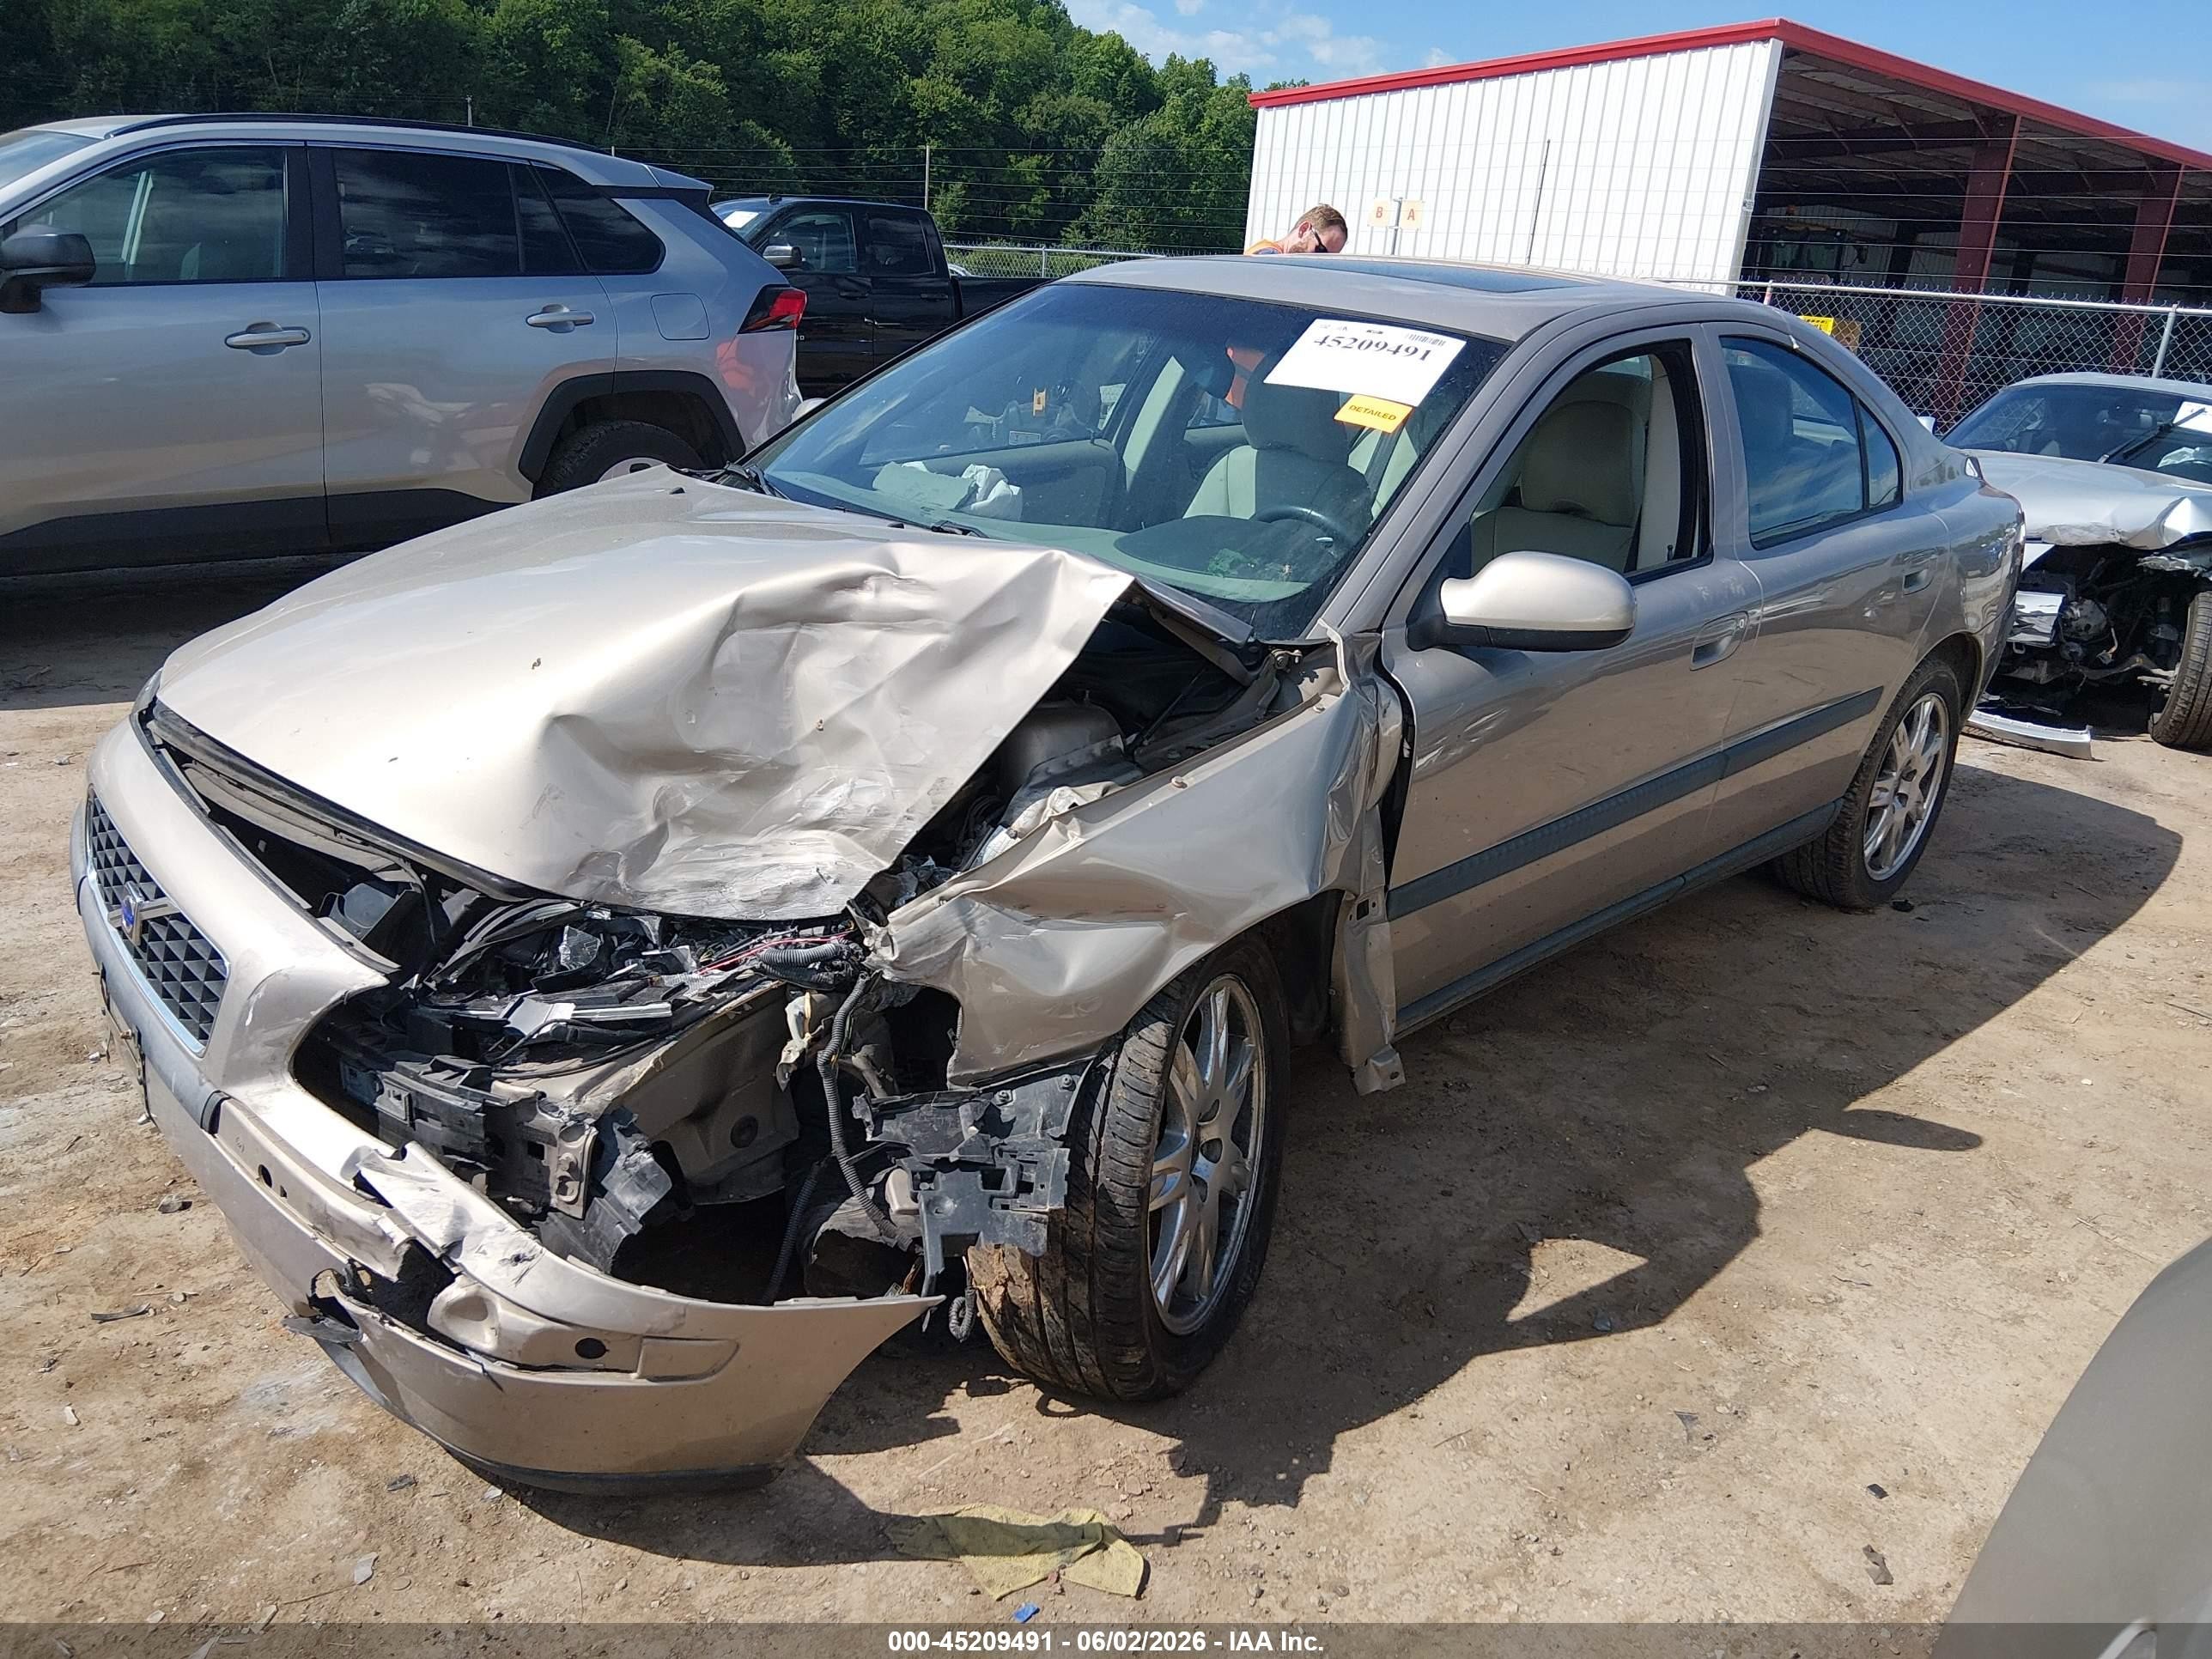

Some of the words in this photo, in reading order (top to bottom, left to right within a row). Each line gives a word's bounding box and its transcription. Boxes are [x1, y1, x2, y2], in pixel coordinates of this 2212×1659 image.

[1407, 208, 1416, 222] A
[1314, 334, 1432, 362] 45209491
[1348, 404, 1397, 421] DETAILED
